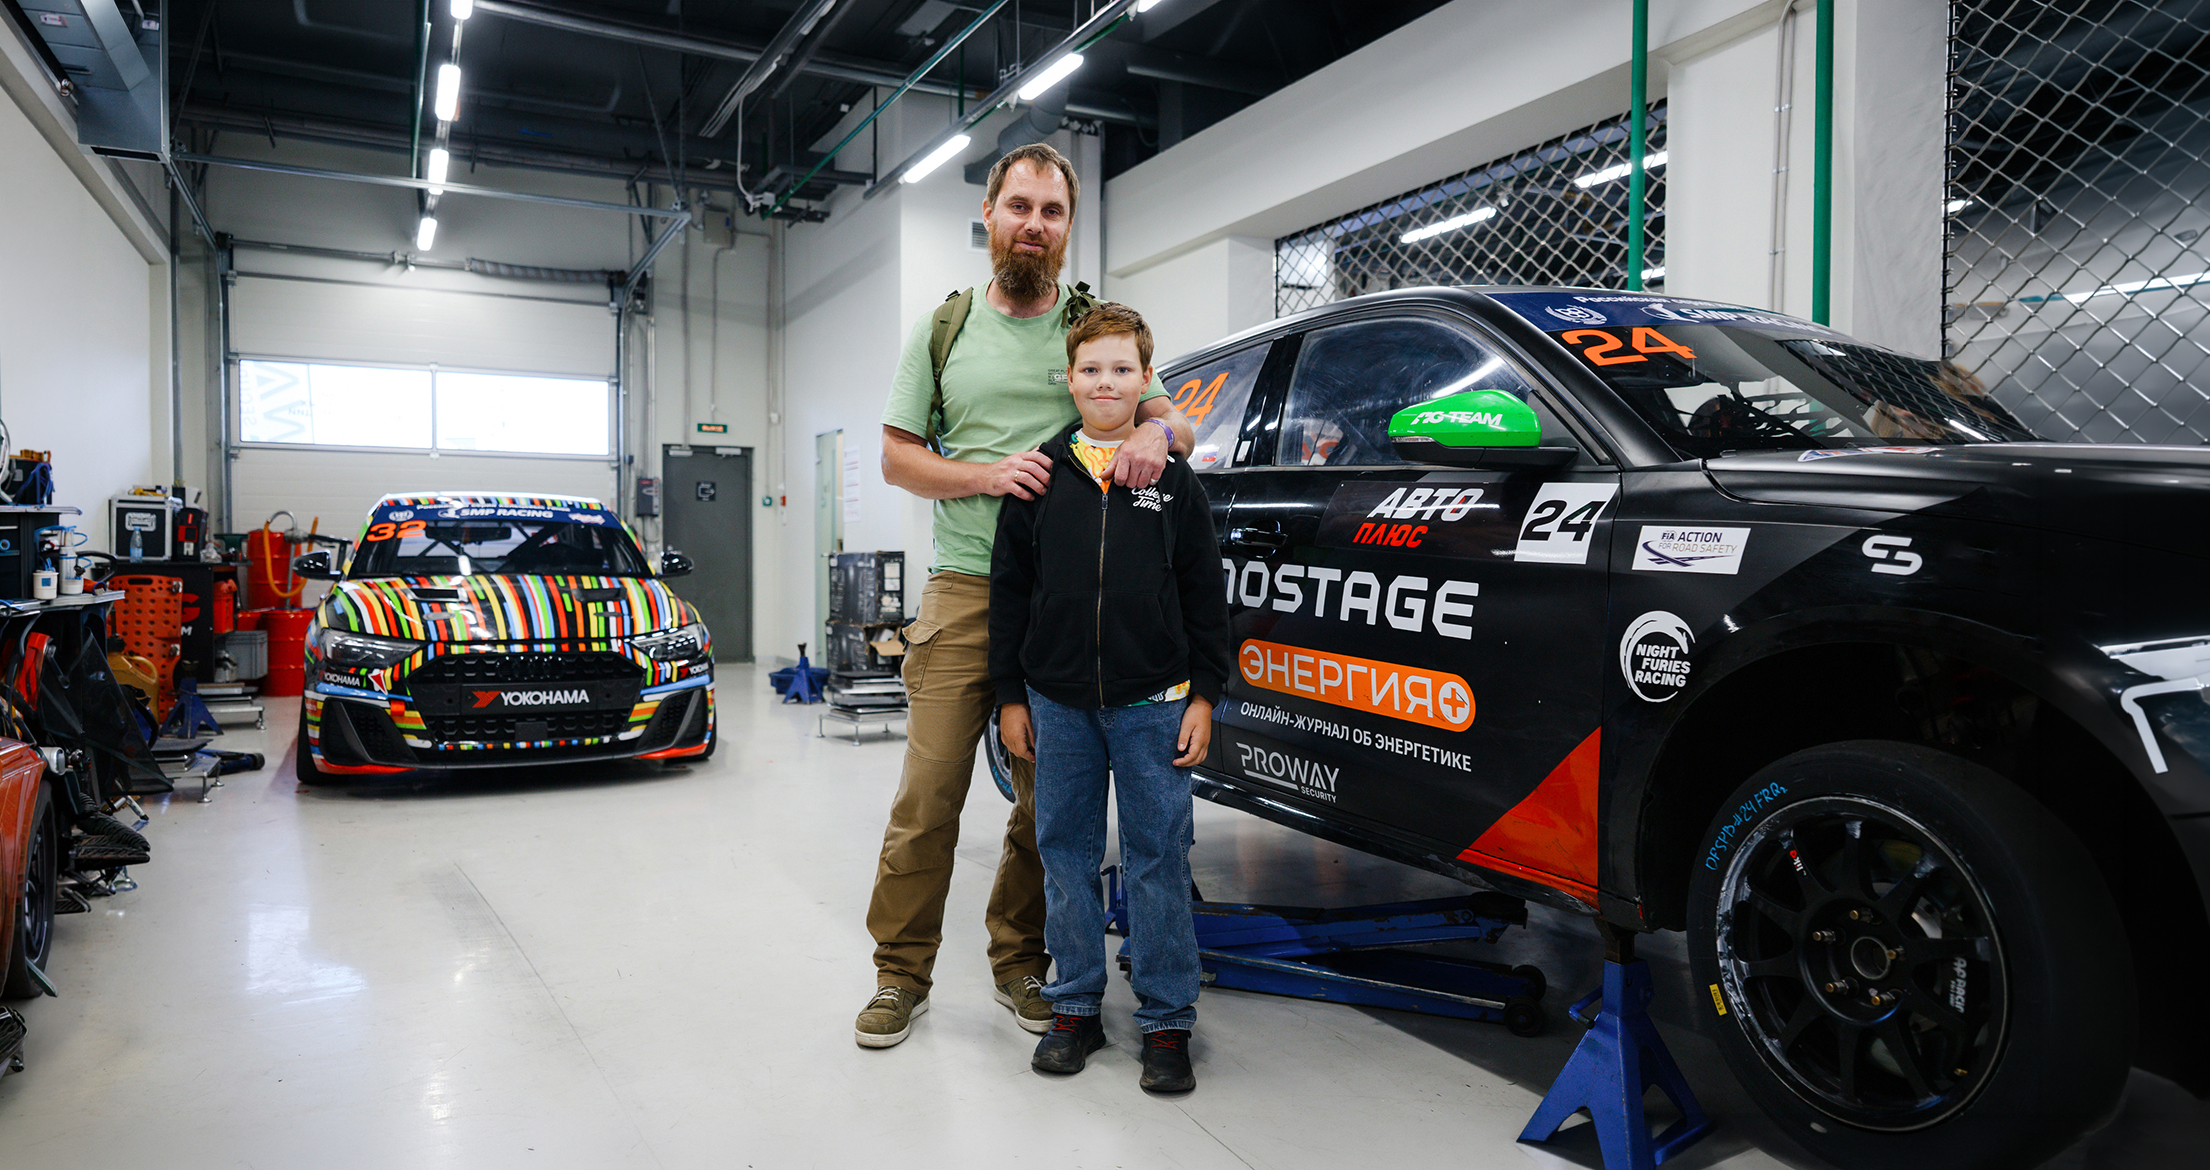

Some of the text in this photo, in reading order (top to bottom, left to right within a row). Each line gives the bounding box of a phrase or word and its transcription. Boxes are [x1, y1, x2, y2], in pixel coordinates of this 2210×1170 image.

[1561, 327, 1697, 366] 24
[1174, 372, 1229, 425] 24
[1449, 411, 1503, 426] TEAM
[461, 507, 494, 518] SMP
[496, 508, 553, 519] RACING
[1133, 496, 1162, 512] Time
[1367, 488, 1484, 522] АВТО
[1520, 500, 1607, 541] 24
[366, 520, 427, 541] 32
[1352, 522, 1428, 548] ПЛЮС
[1678, 531, 1722, 543] ACTION
[1658, 542, 1737, 554] FOR ROAD SAFETY
[1636, 644, 1680, 659] NIGHT
[1641, 657, 1691, 674] FURIES
[1634, 670, 1687, 688] RACING
[501, 689, 589, 706] YOKOHAMA
[1240, 702, 1472, 772] ОНЛАЙН-ЖУРНАЛ ОБ ЭНЕРГЕТИКЕ
[1236, 742, 1339, 792] PROWAY
[1301, 785, 1337, 803] SECURITY
[1955, 978, 1967, 1013] RACIN
